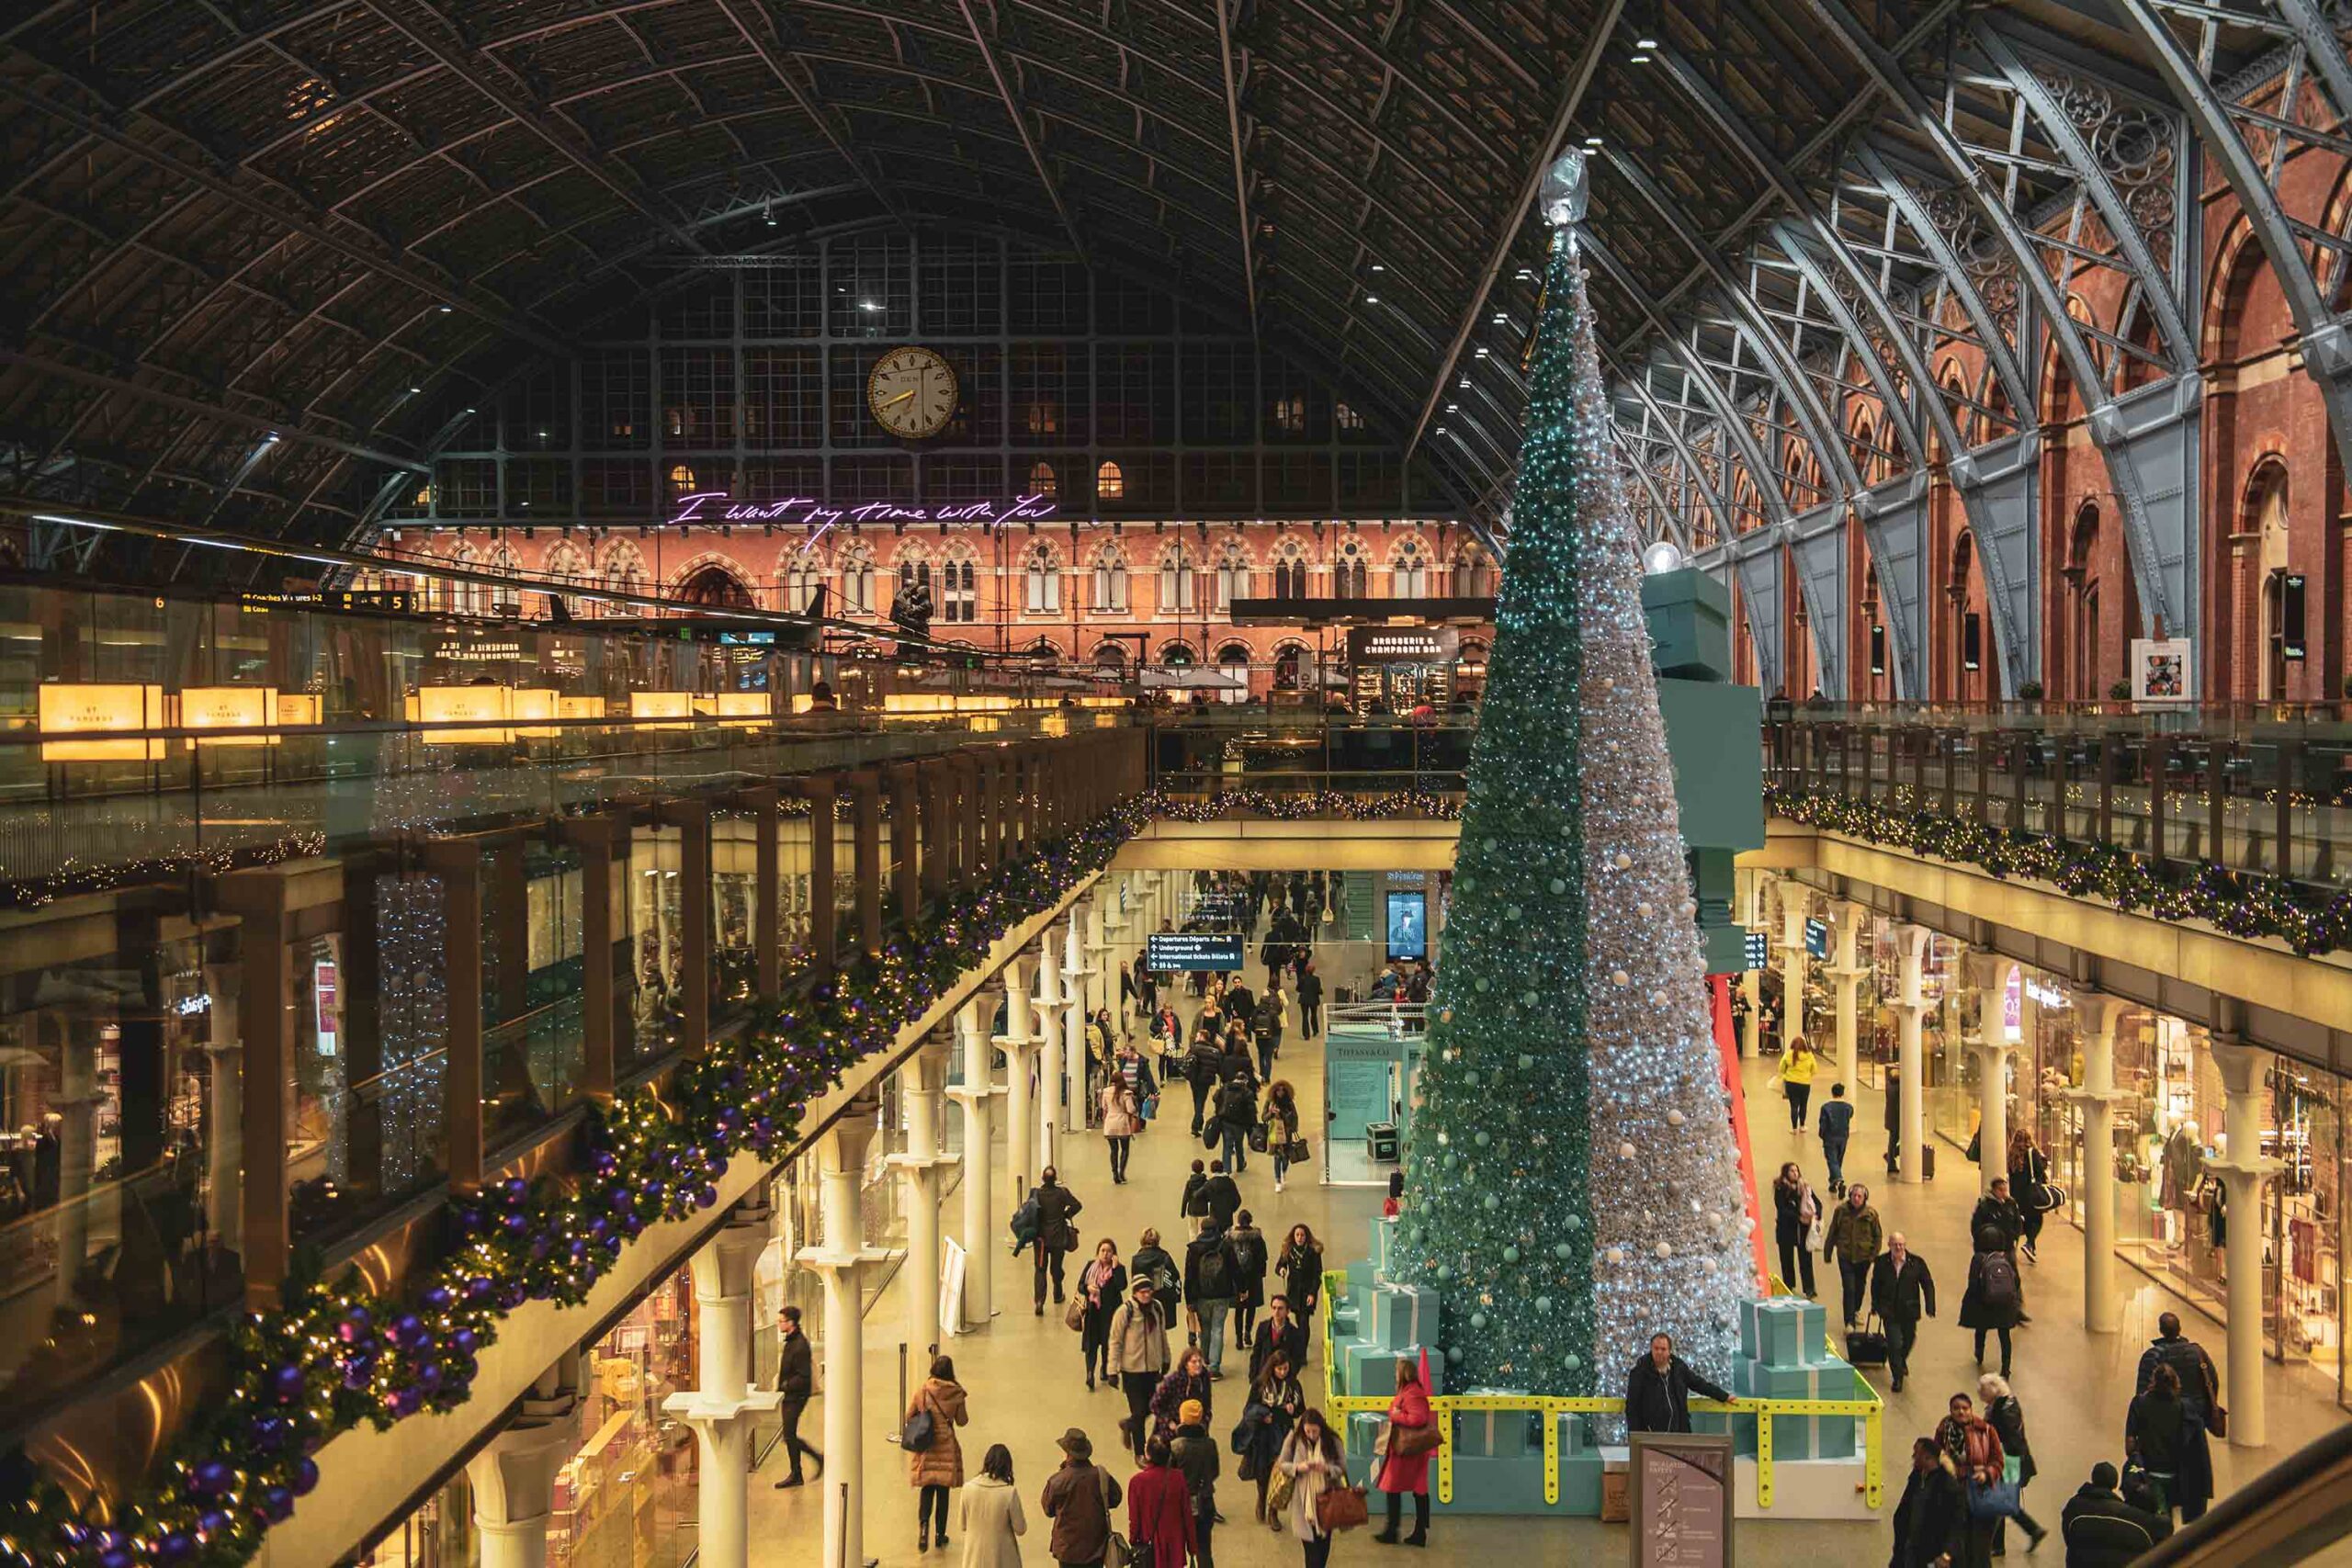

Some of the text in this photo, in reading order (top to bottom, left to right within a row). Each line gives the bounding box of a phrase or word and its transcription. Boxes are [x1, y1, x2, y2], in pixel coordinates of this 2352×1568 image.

[668, 492, 728, 524] I
[726, 498, 814, 521] want
[802, 505, 845, 553] my
[936, 502, 996, 520] with
[156, 597, 164, 608] 6
[392, 596, 402, 609] 5
[1372, 637, 1435, 645] BRASSERIE &
[1364, 646, 1420, 654] CHAMPAGNE
[1338, 1048, 1369, 1056] TIFFANY
